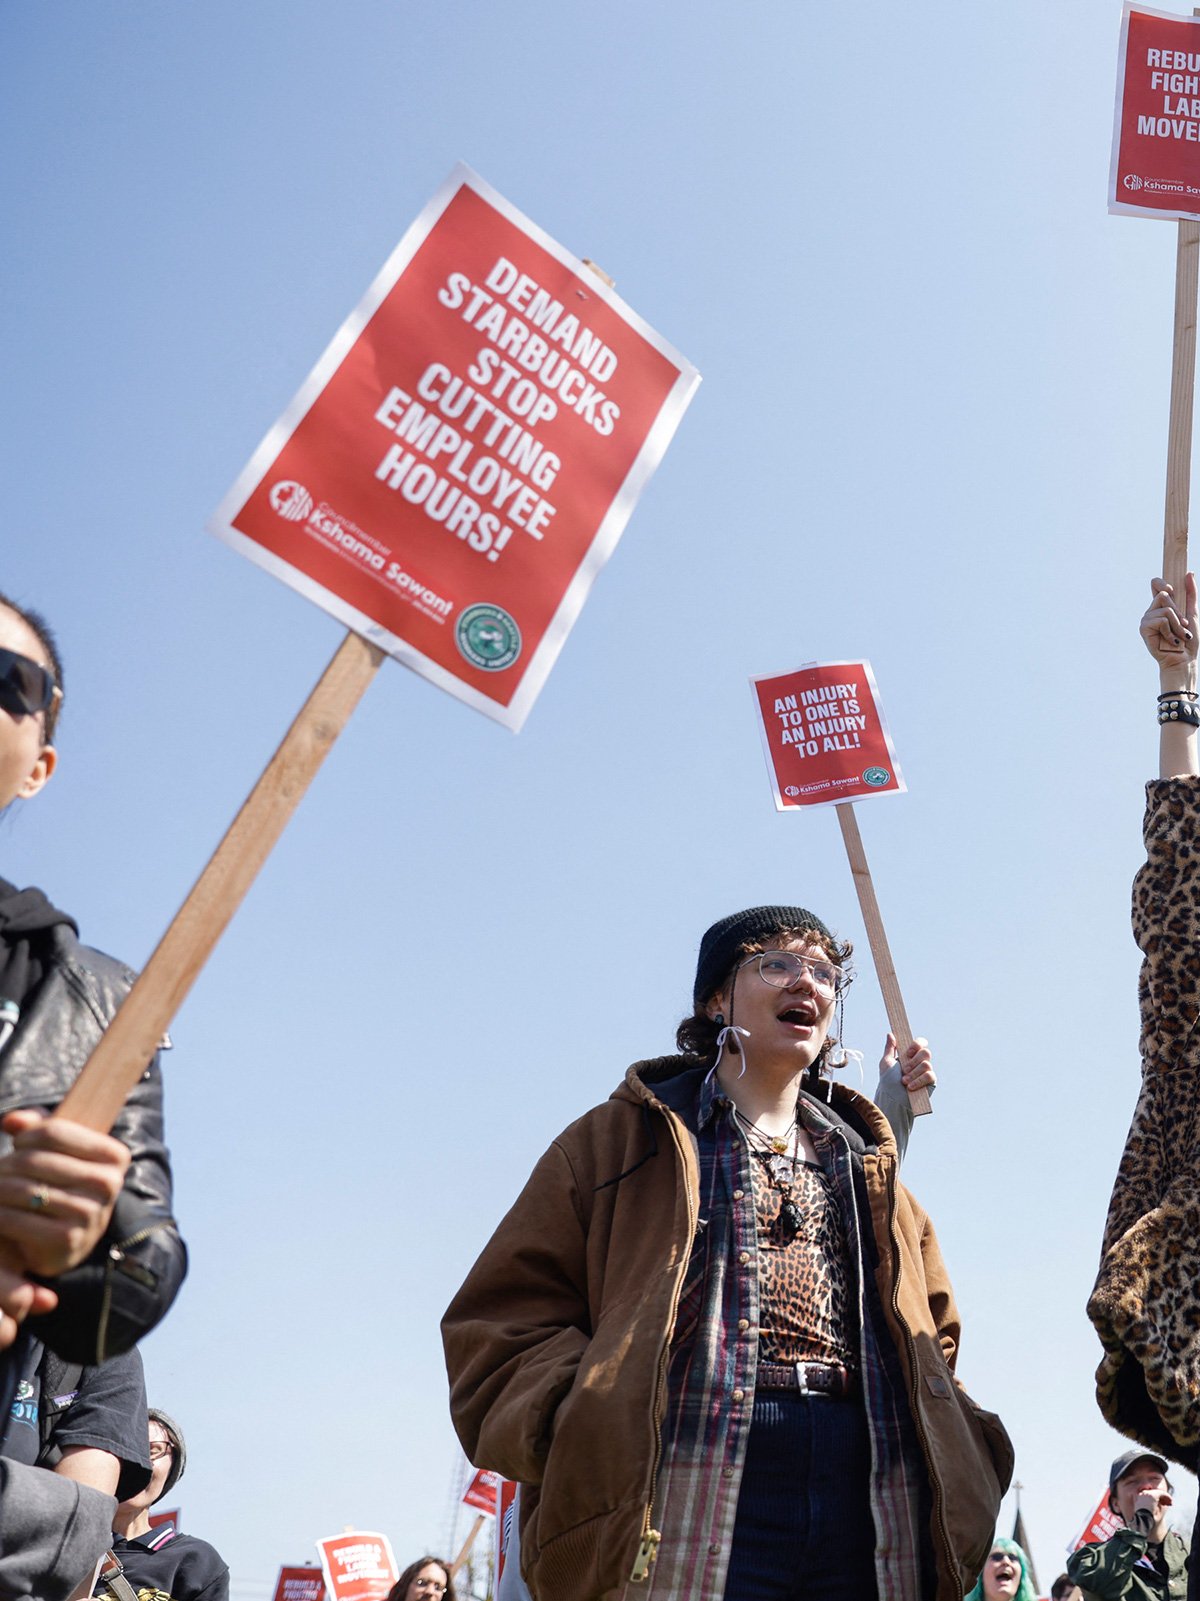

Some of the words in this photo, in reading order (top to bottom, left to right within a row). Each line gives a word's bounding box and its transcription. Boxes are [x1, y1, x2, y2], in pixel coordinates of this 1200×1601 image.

[1144, 180, 1184, 192] Kshama
[438, 273, 620, 436] STARBUCKS
[485, 257, 618, 383] DEMAND
[417, 362, 561, 491] CUTTING
[469, 347, 558, 427] STOP
[374, 387, 557, 540] EMPLOYEE
[374, 445, 514, 563] HOURS!
[309, 510, 386, 571] Kshama
[385, 562, 454, 616] Sawant
[774, 695, 798, 713] AN
[800, 684, 857, 706] INJURY
[779, 712, 802, 728] TO
[805, 702, 840, 721] ONE
[843, 700, 860, 715] IS
[781, 726, 805, 745] AN
[808, 715, 866, 738] INJURY
[795, 740, 818, 759] TO
[824, 733, 861, 752] ALL!
